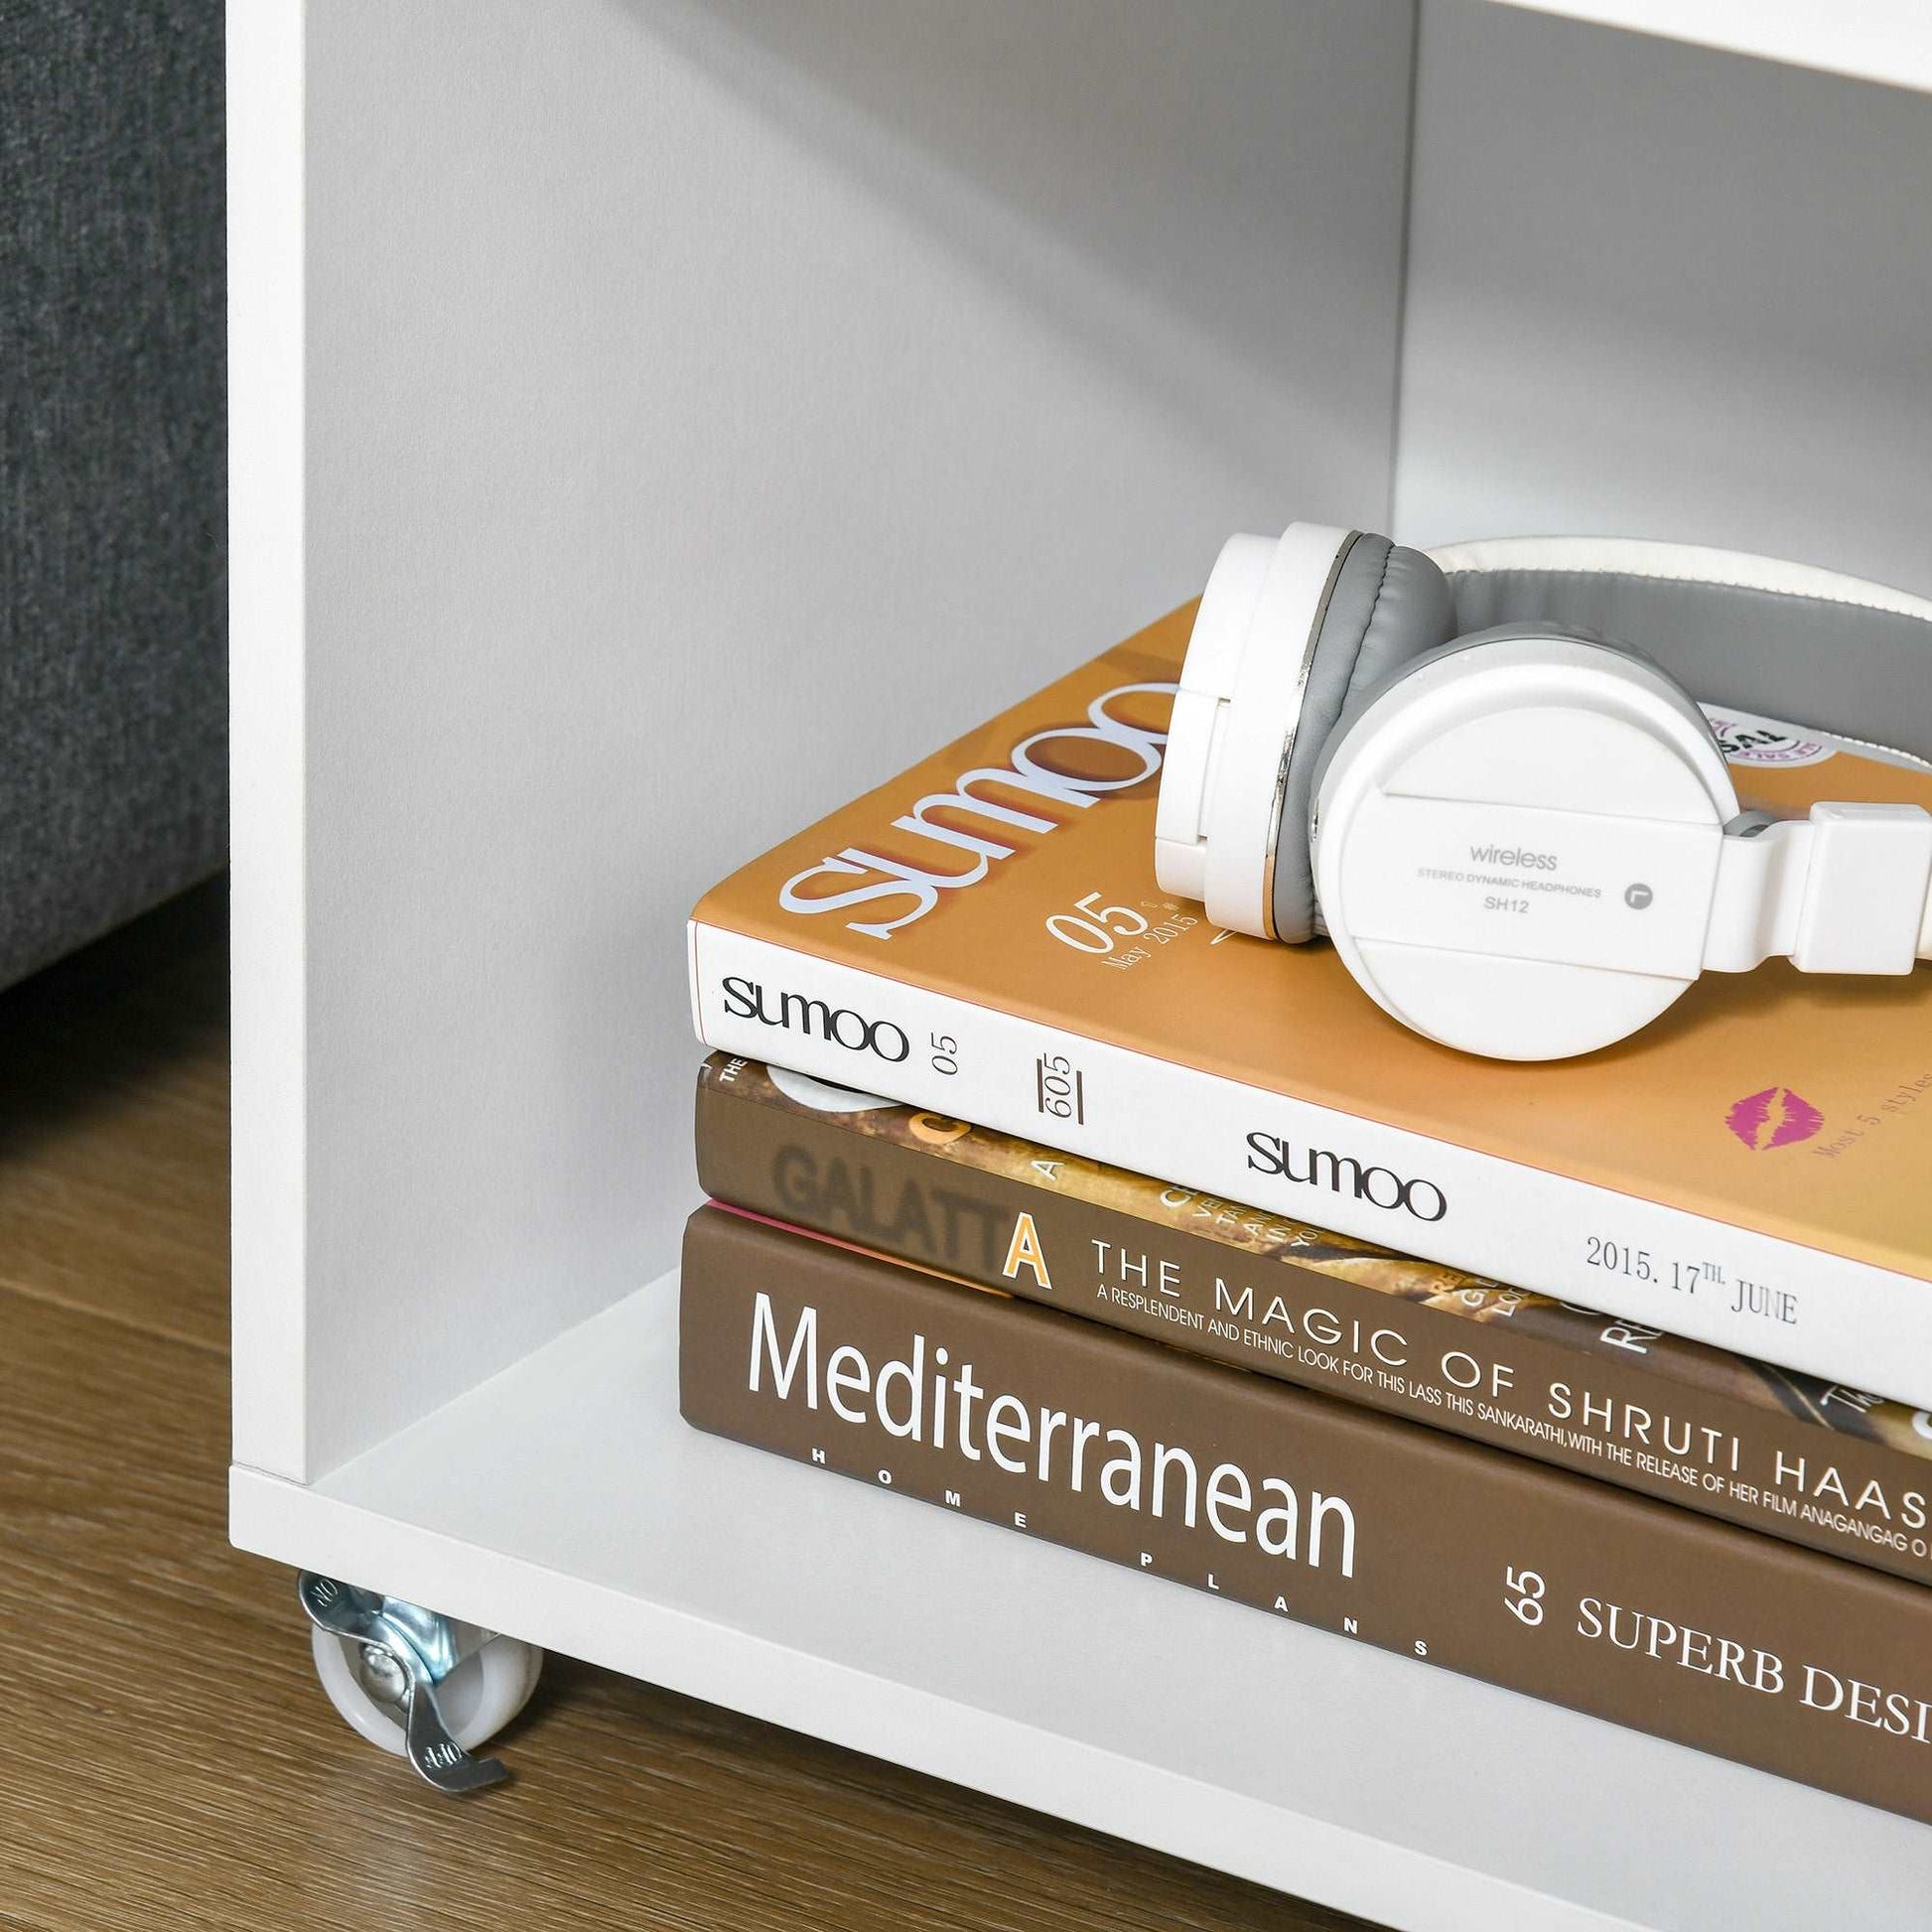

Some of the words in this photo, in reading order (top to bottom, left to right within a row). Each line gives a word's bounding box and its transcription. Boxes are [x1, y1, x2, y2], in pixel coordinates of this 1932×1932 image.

[1417, 867, 1465, 883] STEREO
[1465, 873, 1520, 890] DYNAMIC
[1521, 881, 1602, 898] HEADPHONES
[1470, 845, 1558, 872] wireless
[1045, 892, 1149, 955] 05
[1483, 895, 1530, 914] SH12
[1101, 926, 1152, 971] May
[1143, 913, 1199, 945] 2015
[719, 1058, 749, 1083] THE
[931, 1035, 959, 1076] 05
[1044, 1052, 1072, 1119] 605
[1812, 1129, 1865, 1160] Most
[1857, 1114, 1881, 1125] 5
[1587, 1236, 1659, 1285] 2015.
[1730, 1278, 1798, 1325] JUNE
[1091, 1238, 1181, 1298] THE
[1214, 1277, 1408, 1366] MAGIC
[1441, 1351, 1515, 1398] OF
[1547, 1382, 1739, 1472] SHRUTI
[1774, 1449, 1927, 1530] HAAS
[748, 1292, 1356, 1578] Mediterranean
[1096, 1283, 1109, 1302] A
[1111, 1287, 1204, 1330] RESPLENDENT
[1207, 1318, 1240, 1341] AND
[1243, 1328, 1295, 1359] ETHNIC
[1298, 1345, 1340, 1374] LOOK
[1343, 1359, 1373, 1384] FOR
[1377, 1370, 1405, 1394] THIS
[1408, 1380, 1443, 1406] LASS
[1446, 1392, 1474, 1416] THIS
[1607, 1443, 1632, 1466] THE
[1636, 1450, 1699, 1487] RELEASE
[1702, 1473, 1725, 1493] OF
[1729, 1480, 1759, 1505] HER
[1762, 1491, 1798, 1517] FILM
[1799, 1503, 1909, 1552] ANAGANGAG
[811, 1447, 1027, 1529] HOME
[1141, 1551, 1429, 1656] PLANS
[1504, 1565, 1546, 1627] 65
[1577, 1596, 1785, 1694] SUPERB
[1798, 1664, 1932, 1744] DESI
